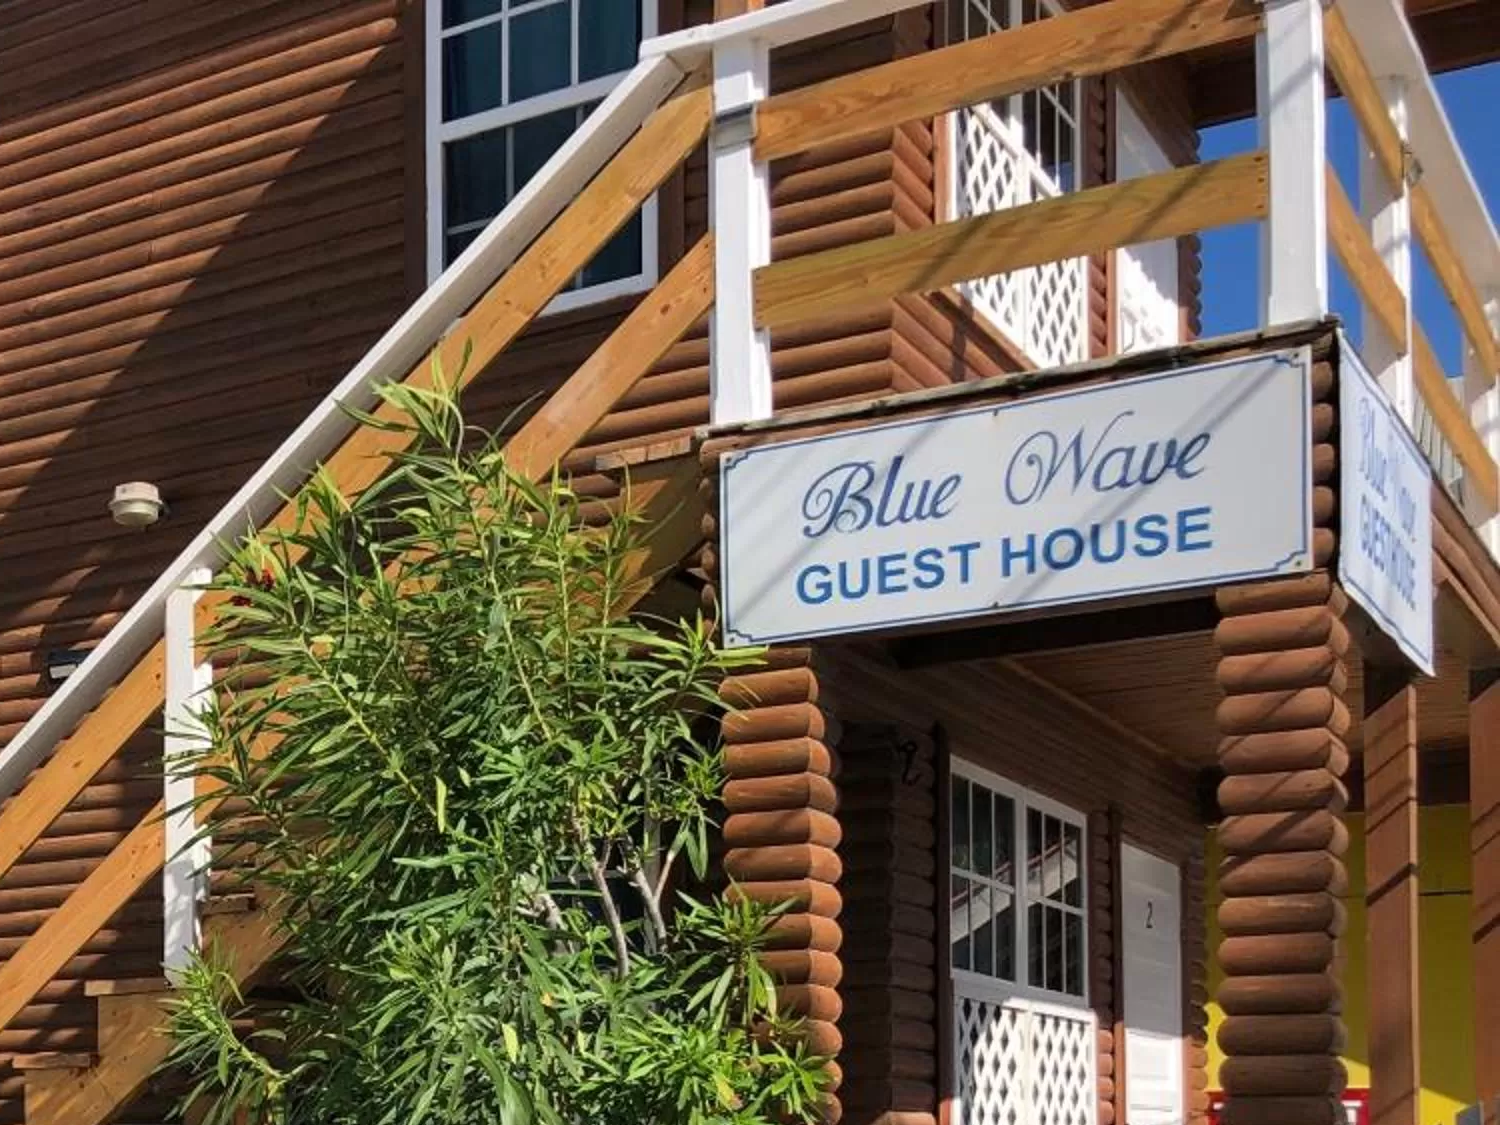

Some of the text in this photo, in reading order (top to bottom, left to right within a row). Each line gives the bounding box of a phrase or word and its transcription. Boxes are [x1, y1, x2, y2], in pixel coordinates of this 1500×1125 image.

[802, 408, 1211, 538] Blue Wave
[796, 506, 1213, 605] GUEST HOUSE
[1145, 901, 1153, 929] 2
